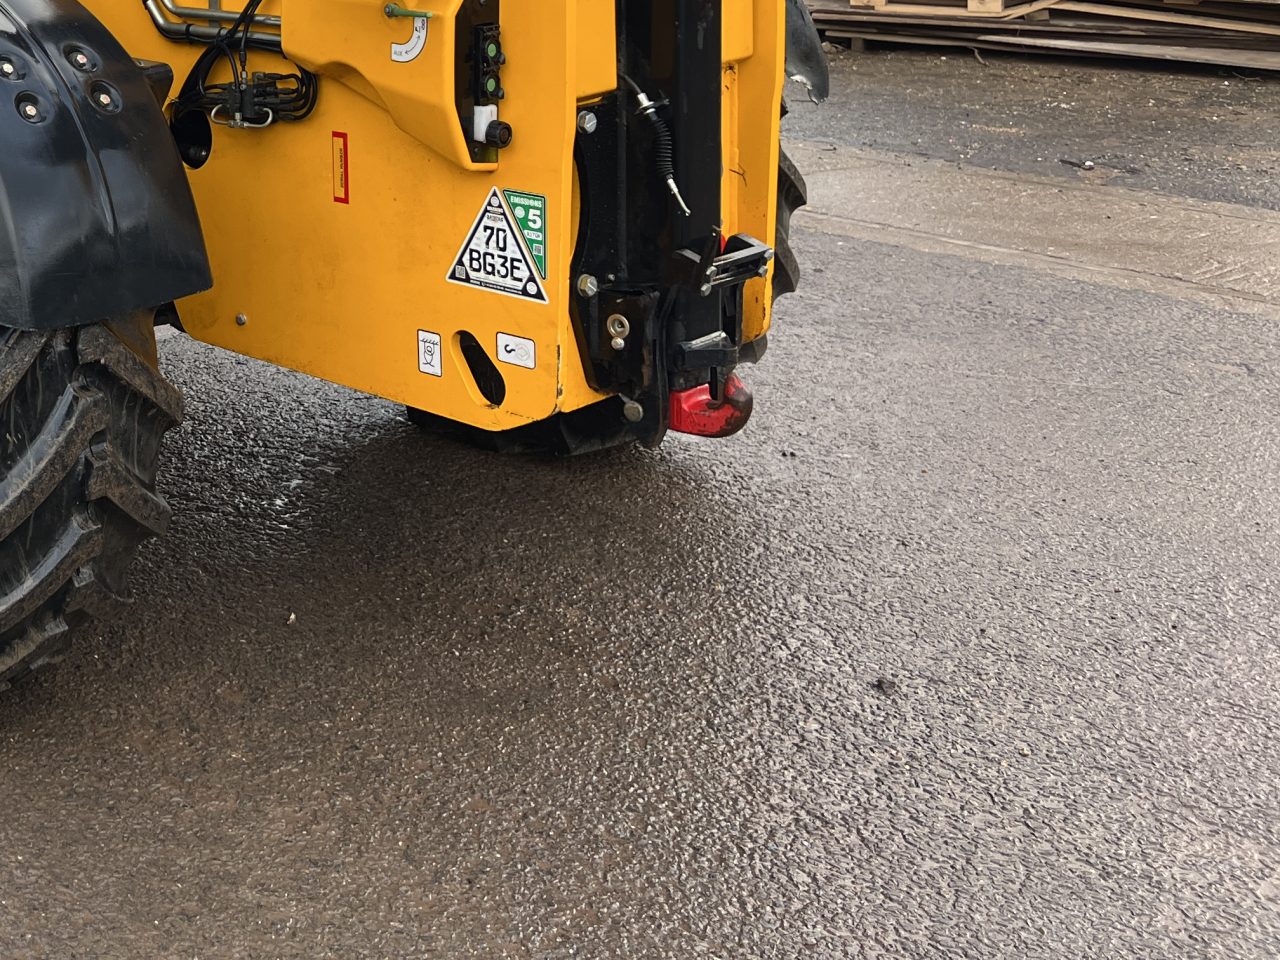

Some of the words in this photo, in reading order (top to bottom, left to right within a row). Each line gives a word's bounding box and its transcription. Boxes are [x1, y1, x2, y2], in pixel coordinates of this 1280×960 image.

[510, 195, 542, 208] EMISSIONS
[527, 208, 542, 230] 5
[468, 247, 524, 283] BG3E
